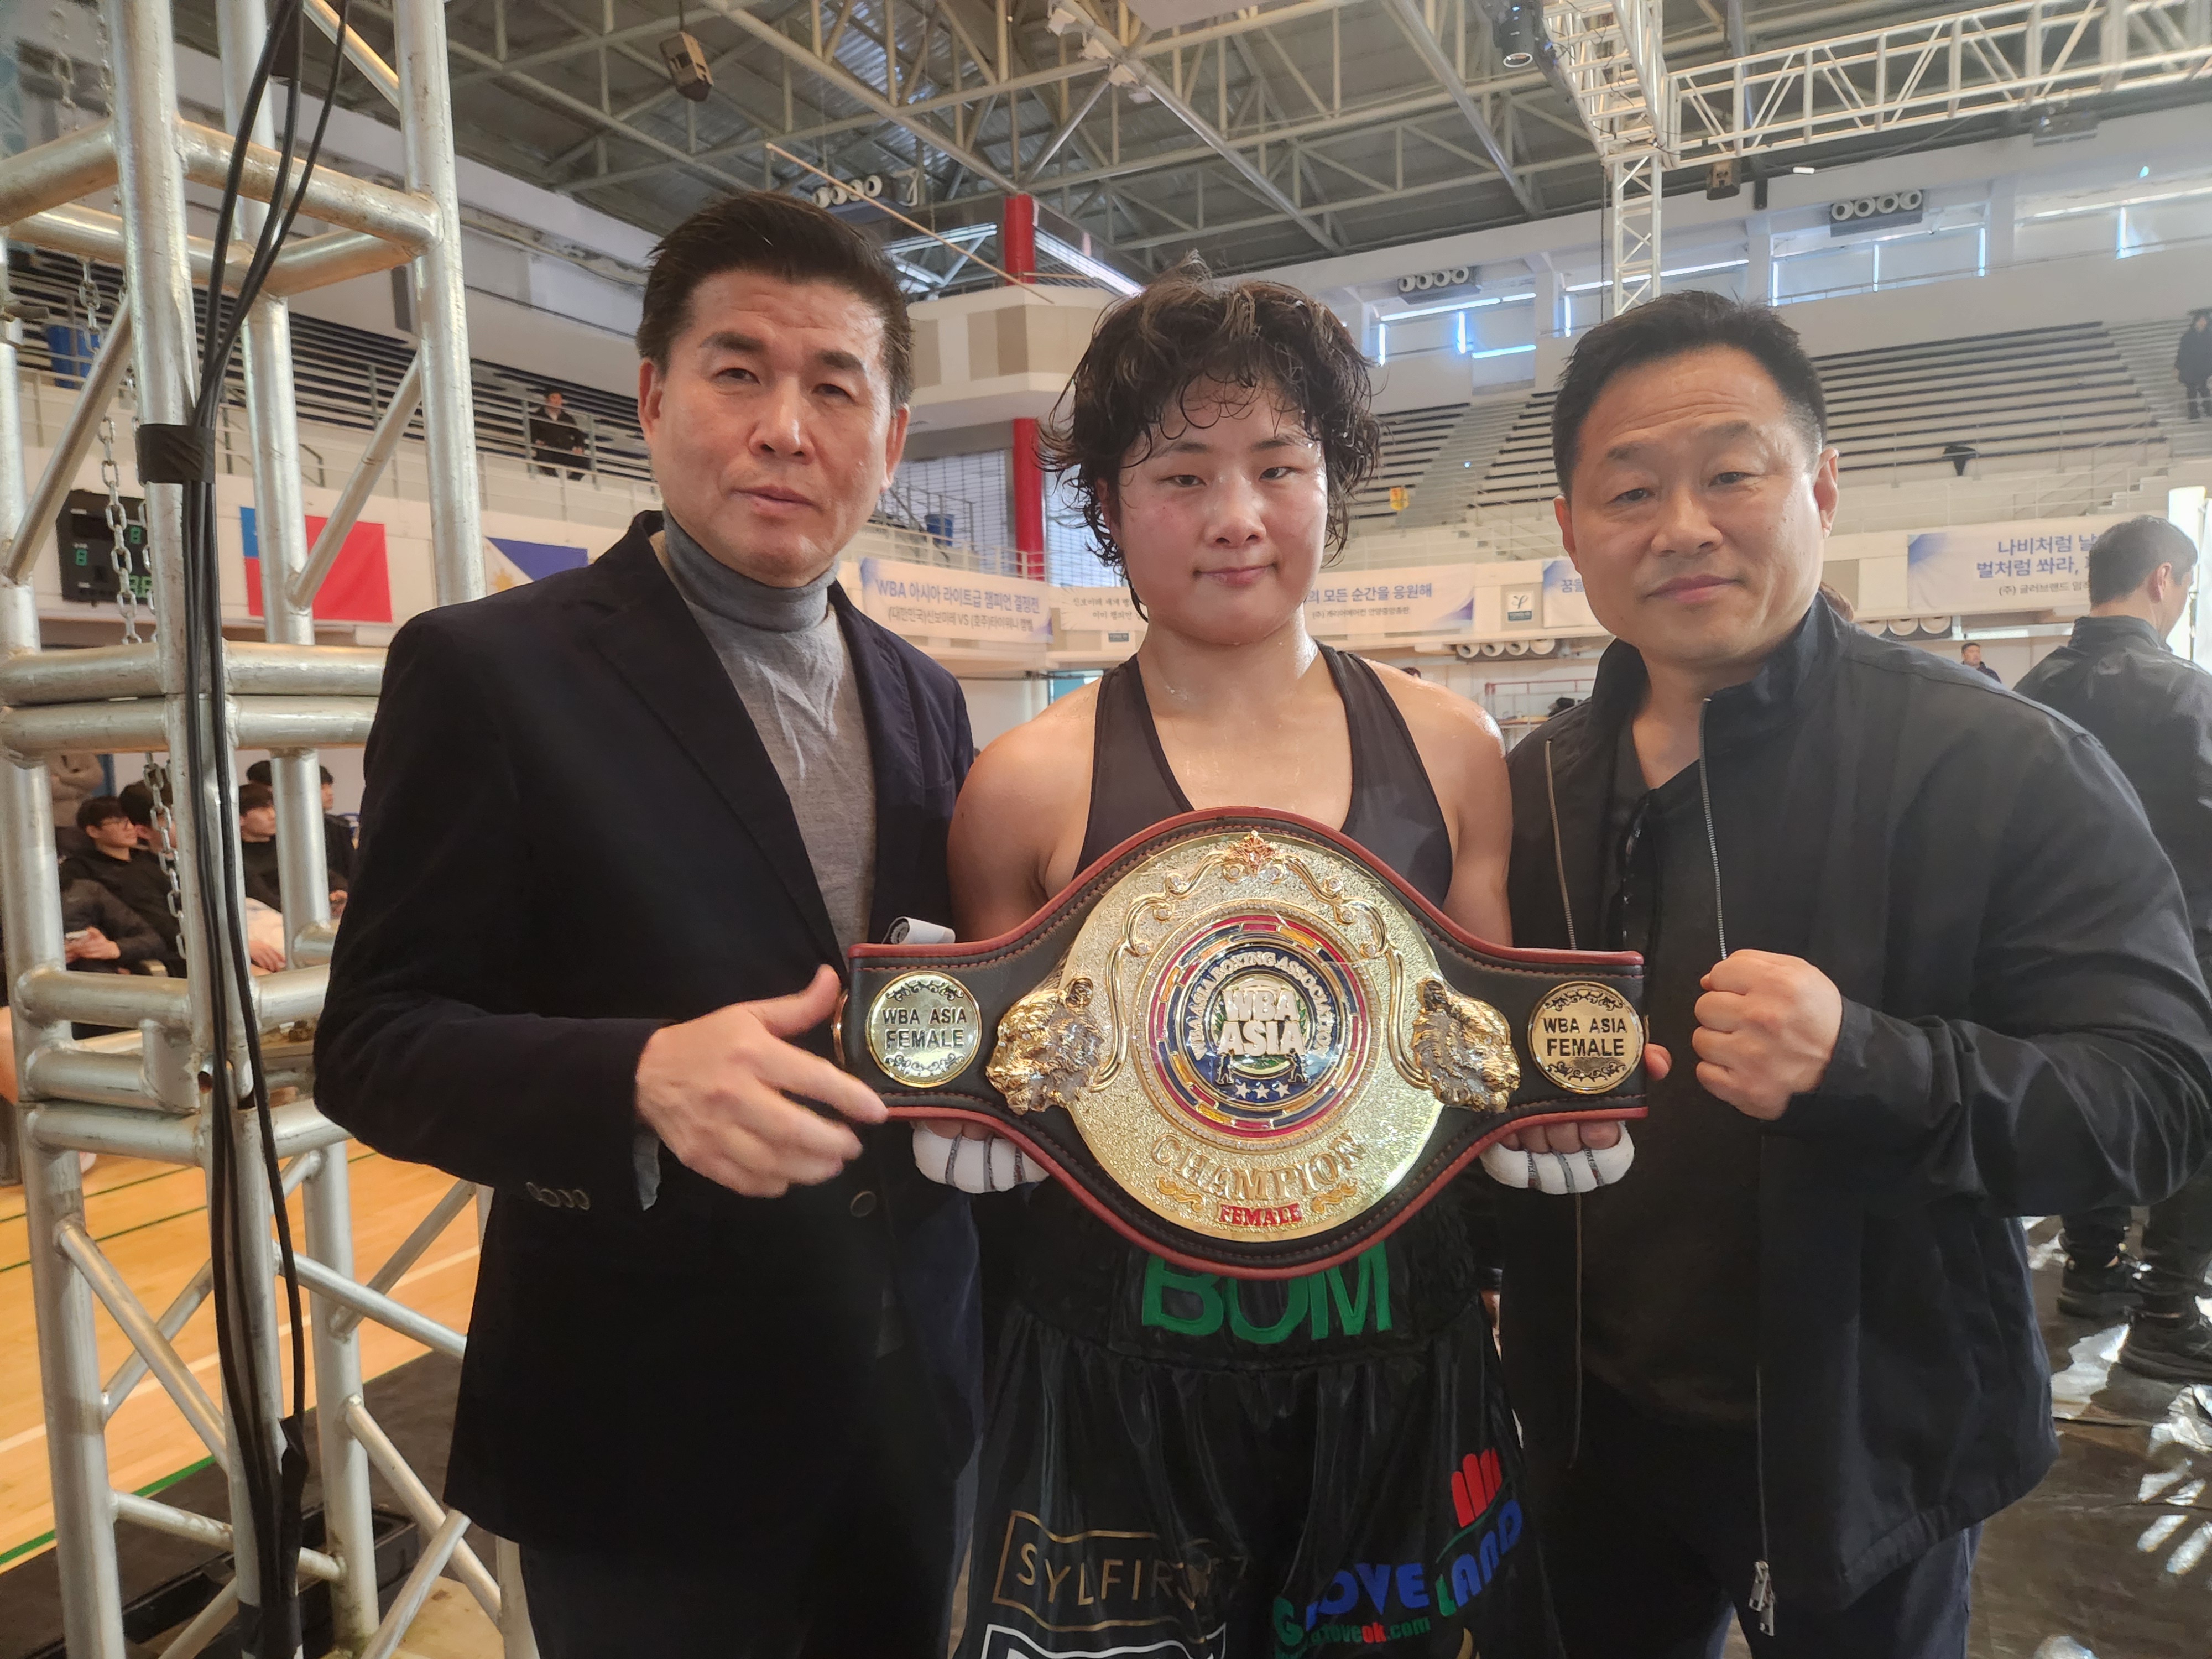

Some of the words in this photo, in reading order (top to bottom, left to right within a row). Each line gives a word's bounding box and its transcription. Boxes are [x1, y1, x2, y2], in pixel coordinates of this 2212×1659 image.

[1997, 534, 2072, 556] 나비처럼
[1976, 558, 2031, 578] 벌처럼
[2036, 555, 2079, 576] 쏴라,
[875, 579, 907, 599] WBA
[910, 582, 941, 602] 아시아
[943, 587, 982, 608] 라이트급
[984, 591, 1013, 611] 챔피언
[1014, 595, 1041, 614] 결정전
[1323, 588, 1348, 603] 모든
[1351, 586, 1390, 602] 순간을
[1392, 582, 1432, 600] 응원해
[1999, 585, 2017, 596] (주)
[958, 614, 969, 627] VS
[1209, 951, 1277, 980] BOXING
[882, 1007, 920, 1025] WBA
[930, 1006, 967, 1024] ASIA
[1220, 989, 1300, 1021] WBA
[1543, 1018, 1580, 1034] WBA
[1589, 1018, 1627, 1034] ASIA
[885, 1027, 965, 1050] FEMALE
[1218, 1020, 1306, 1057] ASIA
[1546, 1037, 1625, 1057] FEMALE
[1151, 1128, 1366, 1201] CHAMPION
[1218, 1204, 1302, 1225] FEMALE
[1436, 1499, 1522, 1617] LAND
[1016, 1542, 1212, 1610] SYLFIR
